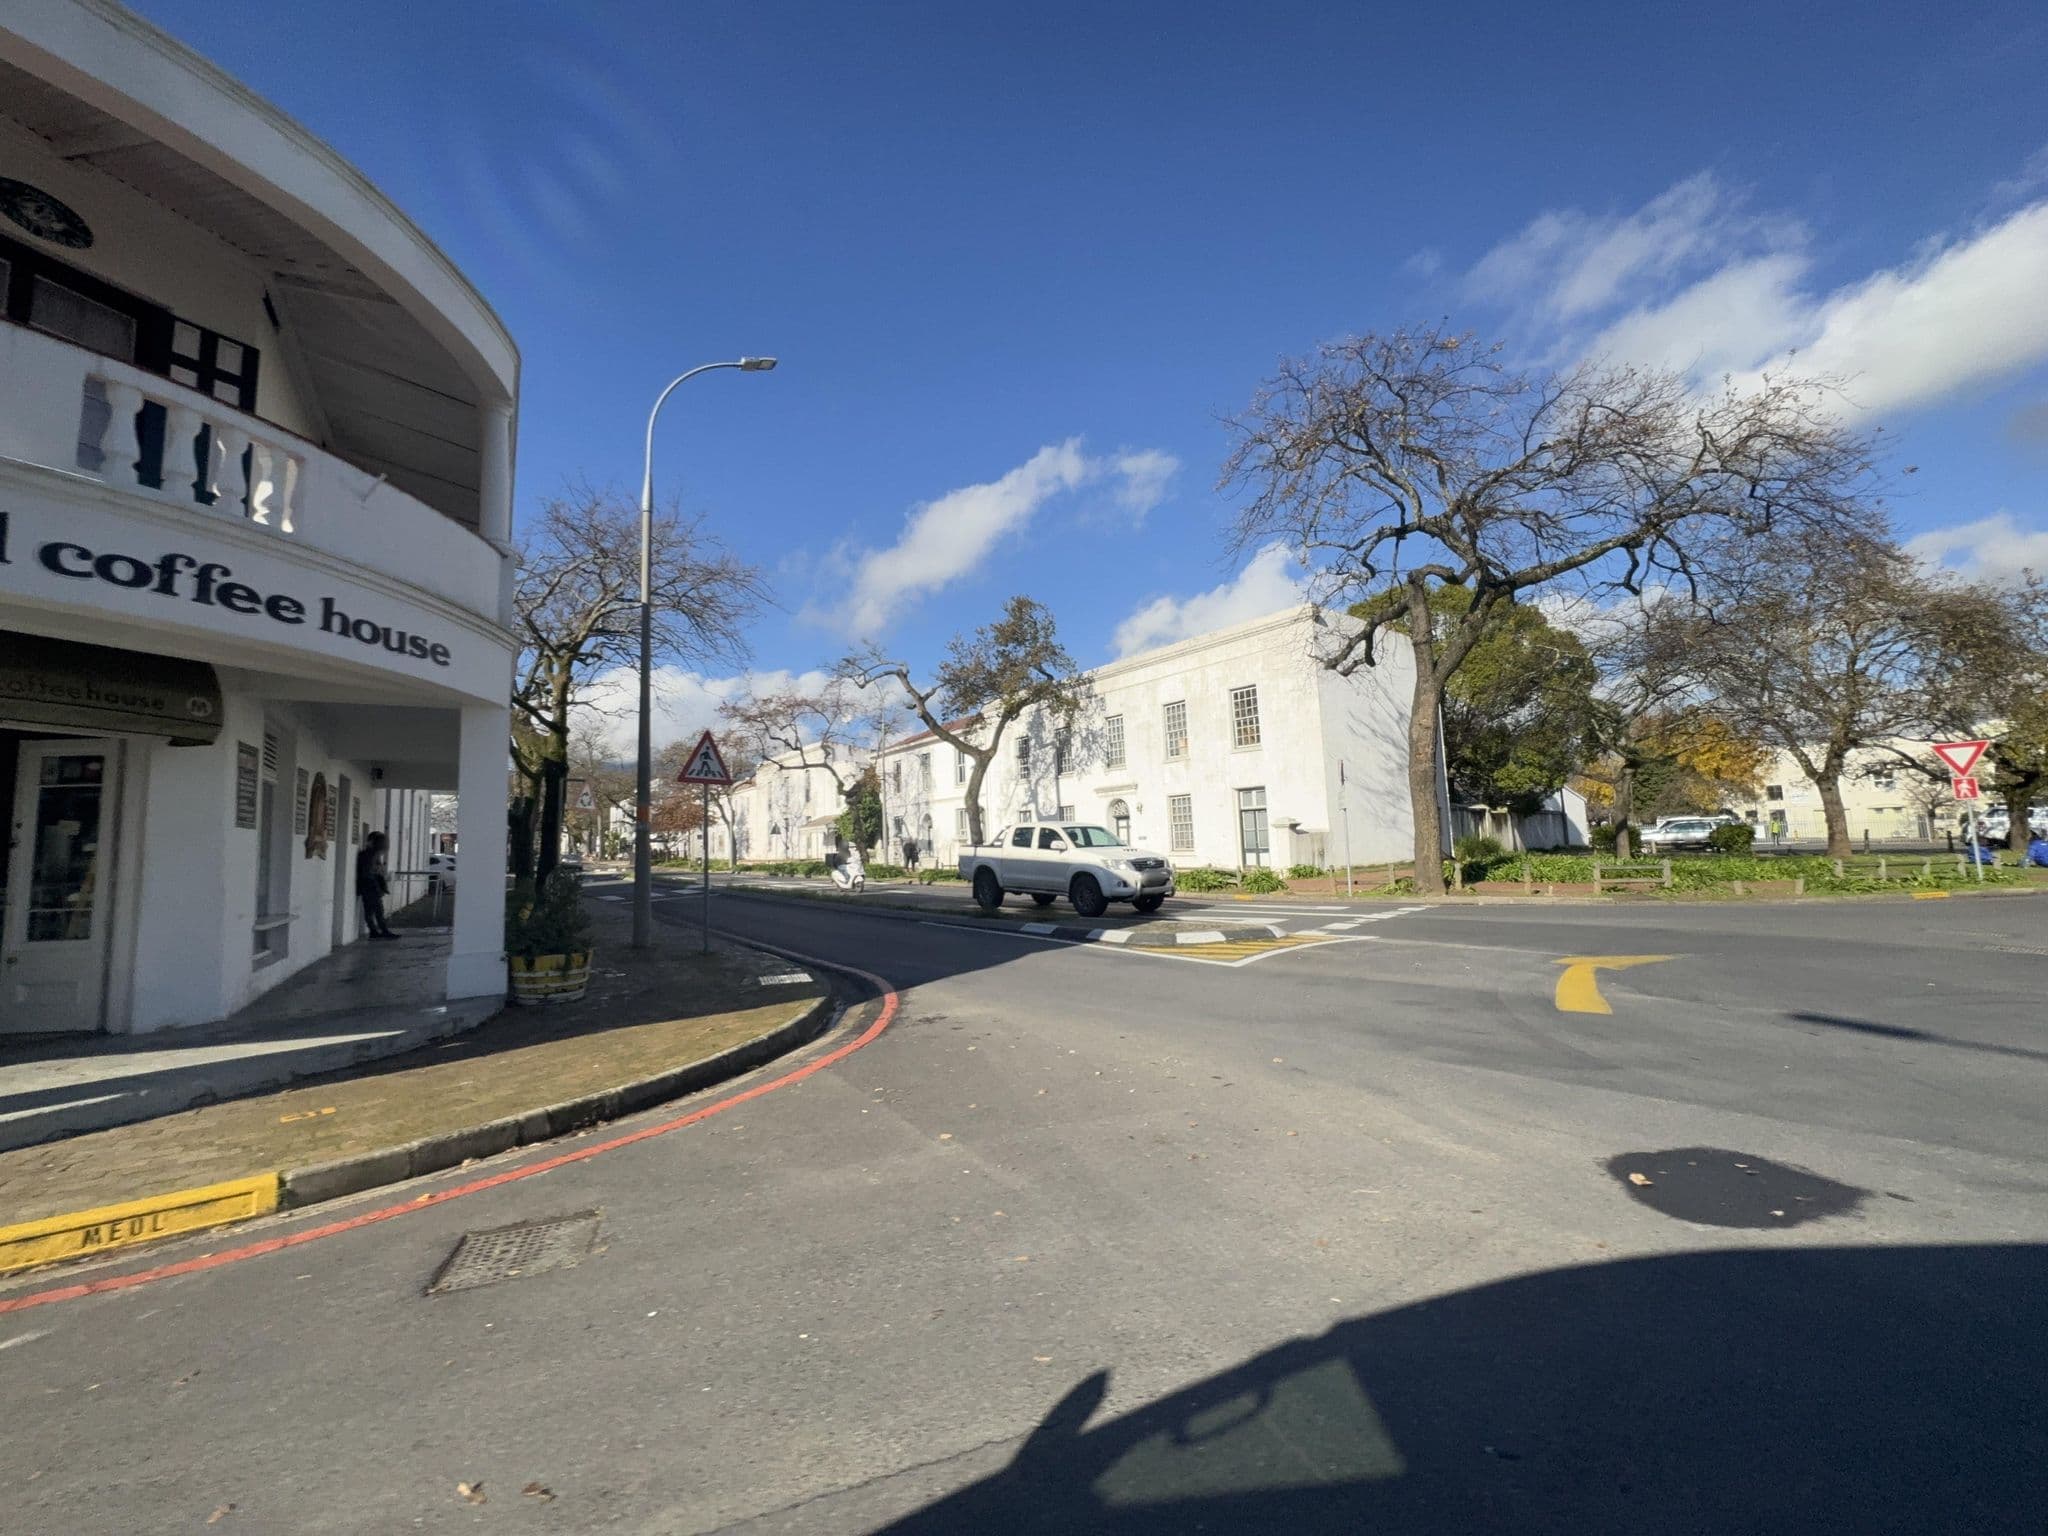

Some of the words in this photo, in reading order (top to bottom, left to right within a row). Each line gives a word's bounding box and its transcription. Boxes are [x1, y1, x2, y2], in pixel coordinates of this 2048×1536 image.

[39, 541, 306, 625] coffee
[319, 597, 451, 667] house
[82, 1214, 164, 1249] MEUL
